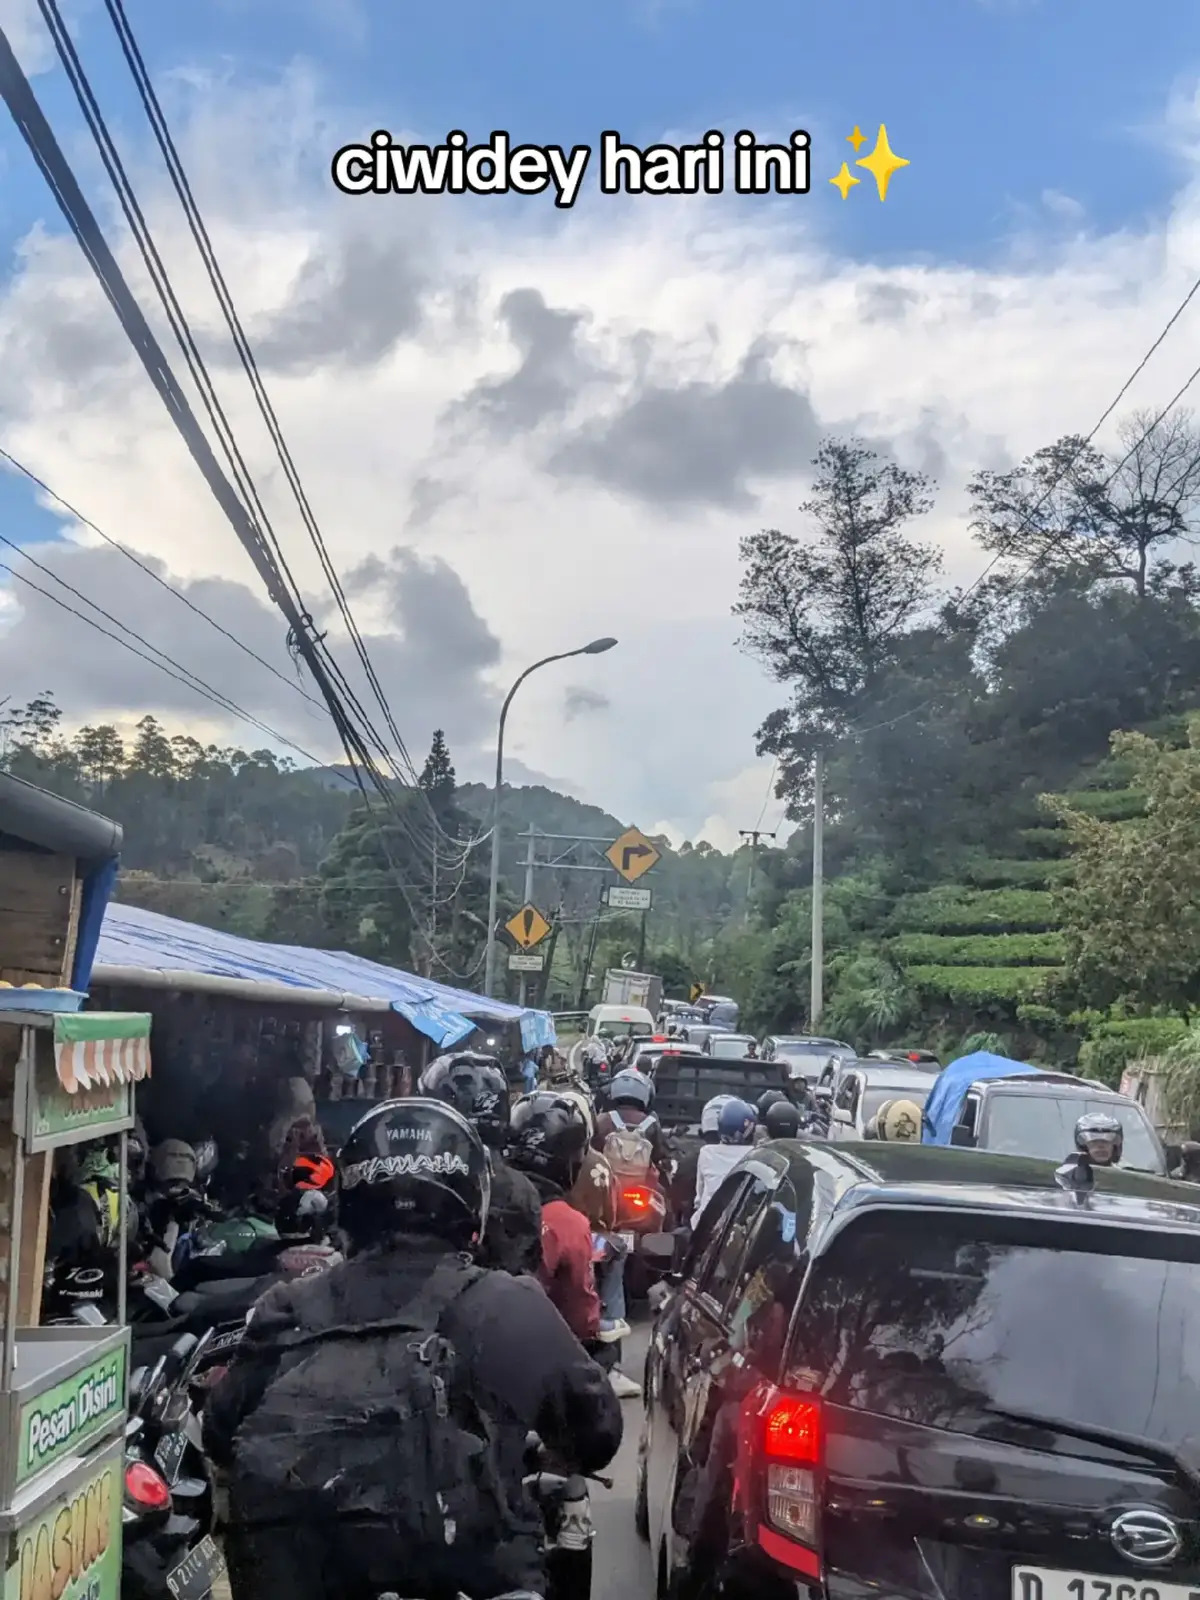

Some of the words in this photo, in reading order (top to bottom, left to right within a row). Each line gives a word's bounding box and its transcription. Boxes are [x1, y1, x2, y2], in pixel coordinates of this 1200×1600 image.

[386, 1128, 432, 1142] YAMAHA
[27, 1396, 76, 1467] Pesan
[78, 1361, 117, 1427] Disini
